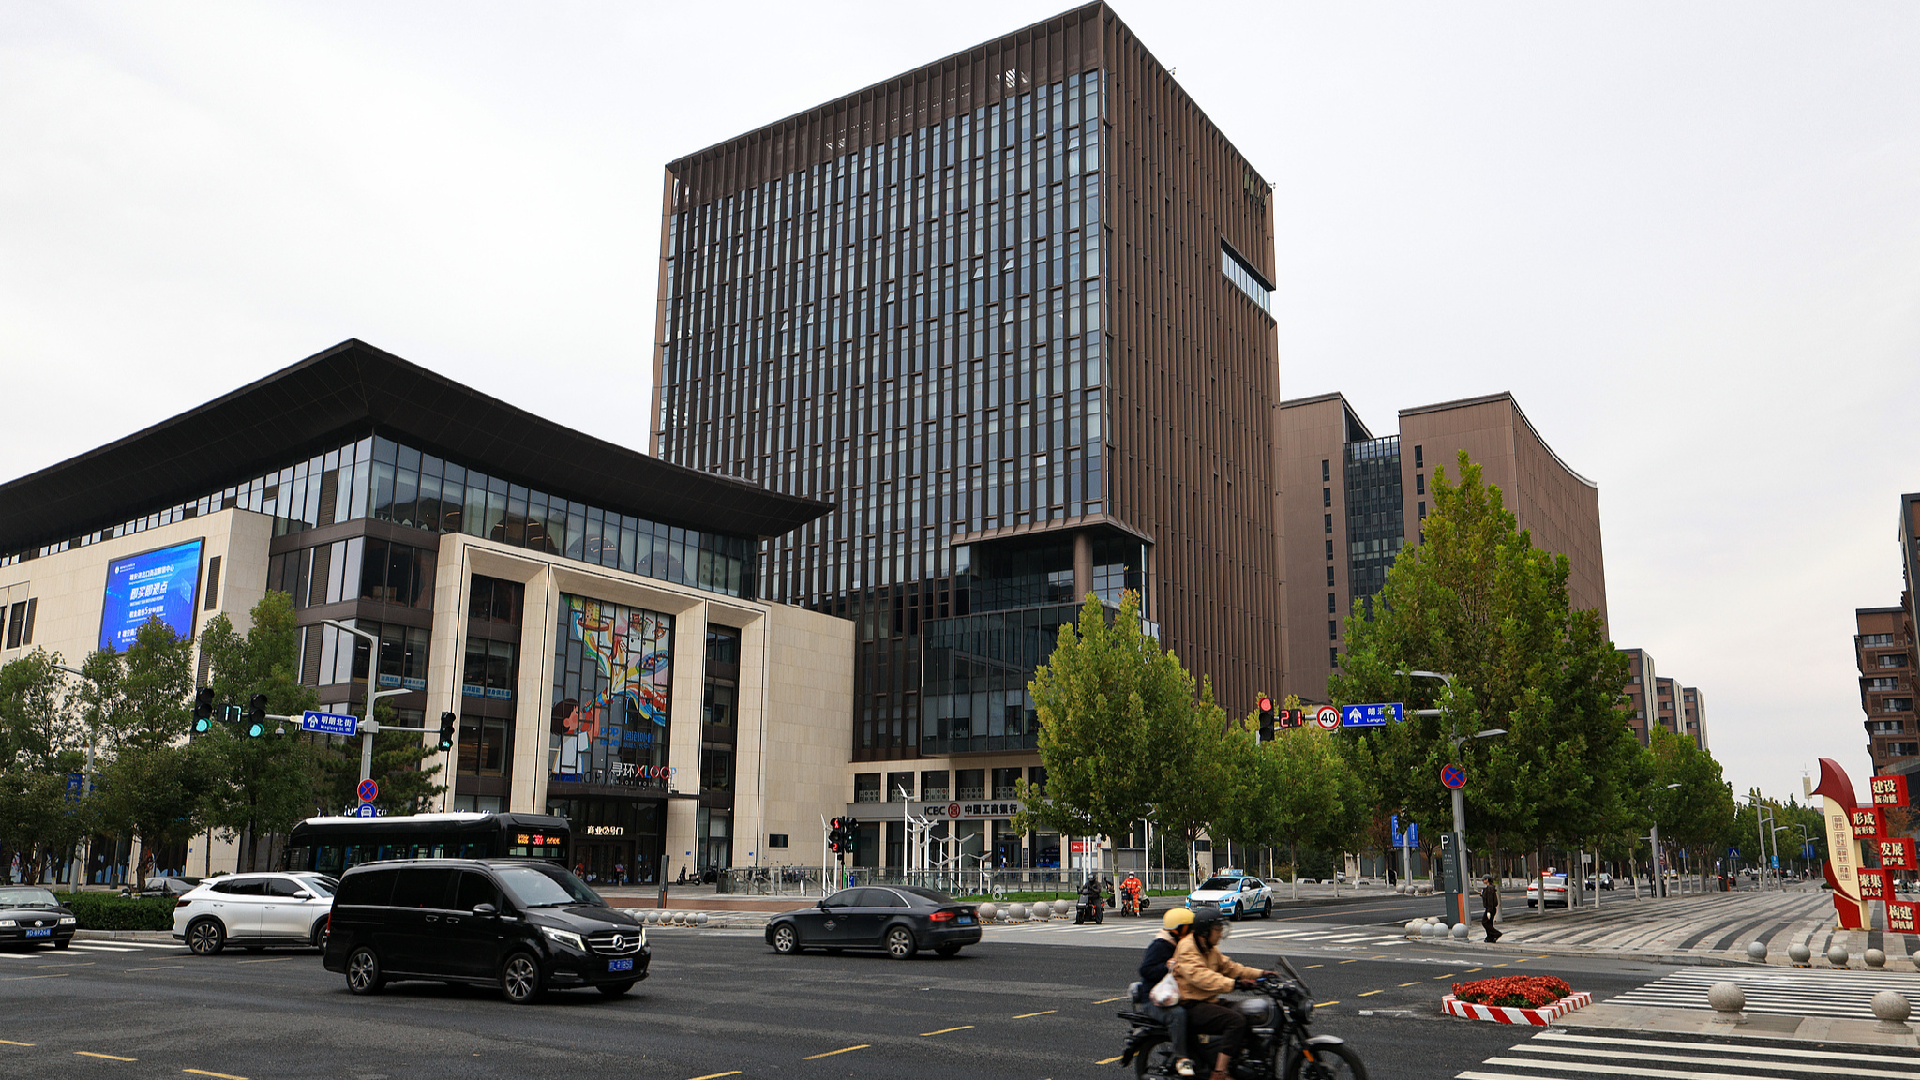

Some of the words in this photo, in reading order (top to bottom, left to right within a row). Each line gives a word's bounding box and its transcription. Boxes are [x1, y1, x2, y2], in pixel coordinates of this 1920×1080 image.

[1281, 710, 1302, 728] 21
[1321, 712, 1336, 724] 40
[610, 762, 635, 778] 寻环
[635, 764, 678, 780] XLOOP
[1872, 780, 1897, 794] 建设
[1874, 794, 1898, 804] 新功能
[924, 806, 946, 816] ICBC
[964, 804, 1018, 816] 中国工商银行
[1853, 812, 1876, 826] 形成
[1854, 826, 1876, 835] 新形象
[1441, 834, 1449, 850] P
[1881, 842, 1905, 856] 发展
[1882, 857, 1906, 866] 新产业
[1859, 874, 1883, 888] 聚集
[1862, 888, 1883, 898] 新人才
[1889, 904, 1913, 920] 构建
[1892, 920, 1914, 930] 新机制
